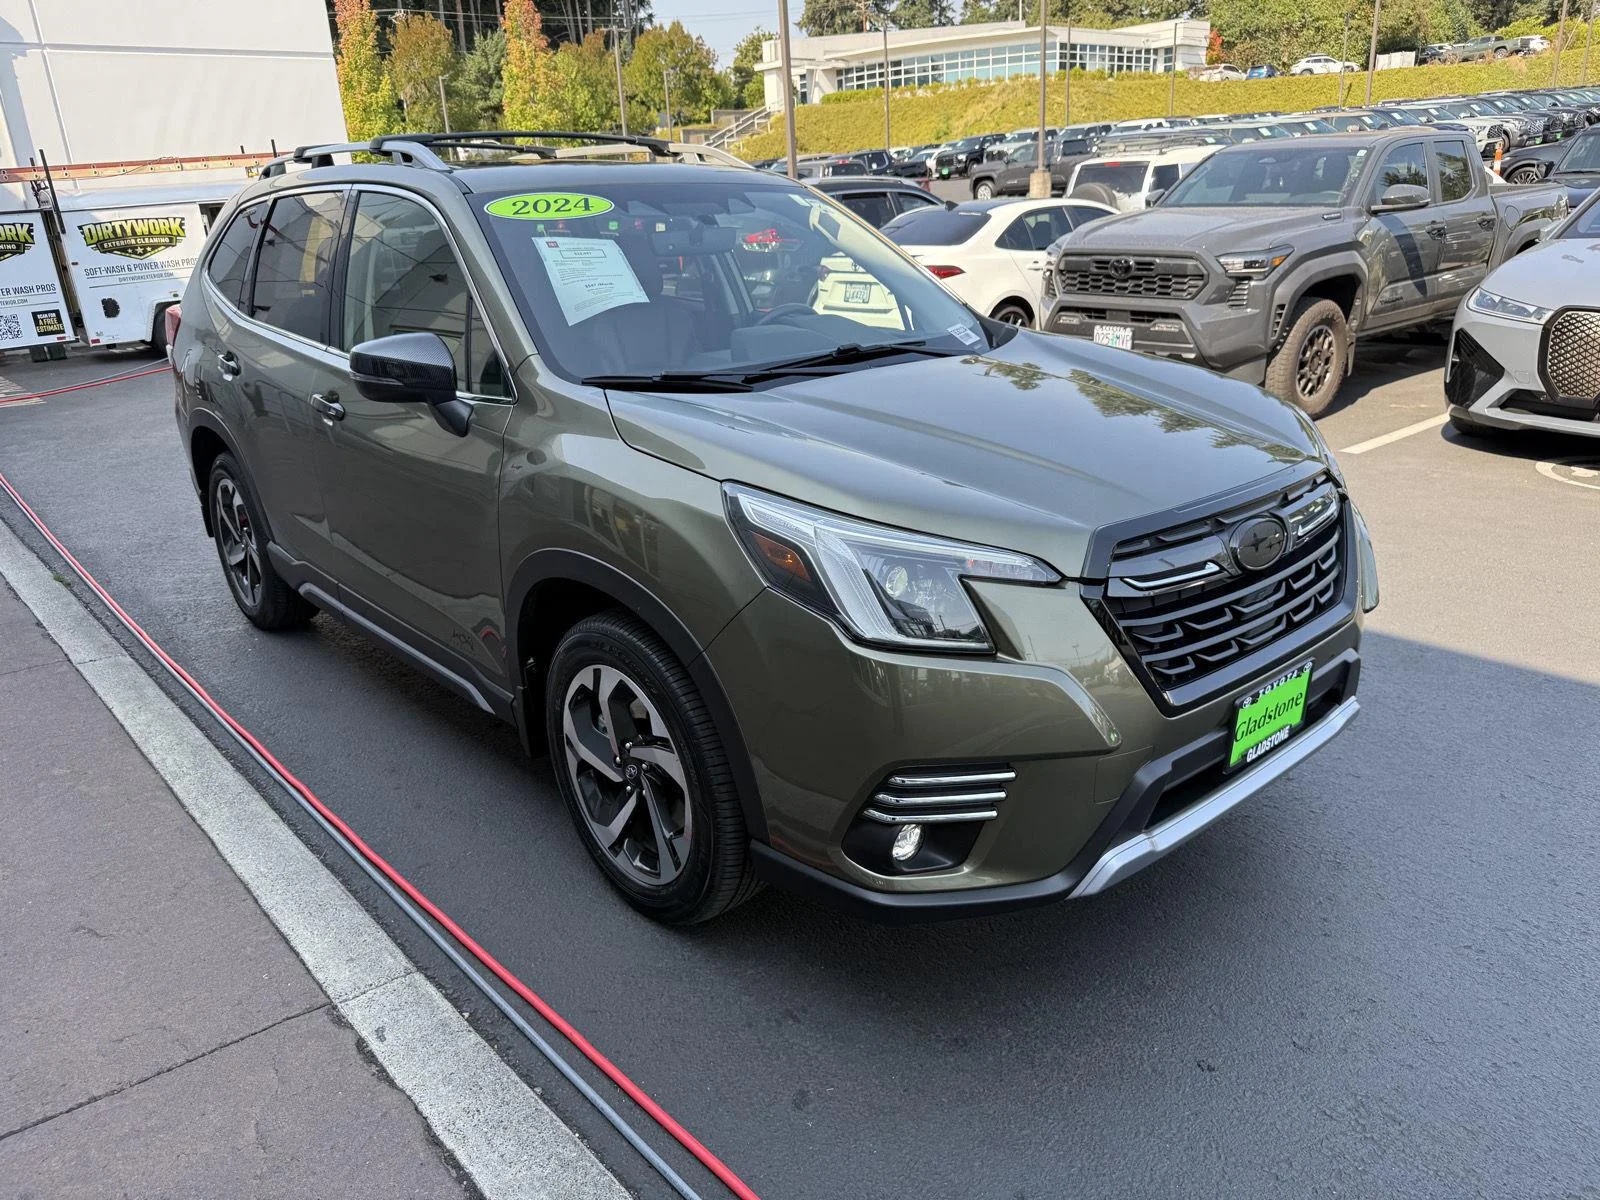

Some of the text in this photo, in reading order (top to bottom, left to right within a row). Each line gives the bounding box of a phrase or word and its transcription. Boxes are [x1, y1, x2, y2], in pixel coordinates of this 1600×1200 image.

[511, 197, 595, 216] 2024
[82, 217, 186, 245] DIRTYWORK
[104, 237, 170, 249] EXTERIOR CLEANING
[84, 265, 126, 277] SOFT-WASH
[127, 264, 132, 272] &
[133, 262, 160, 272] POWER
[160, 259, 180, 269] WASH
[12, 285, 35, 295] WASH
[36, 283, 56, 293] PROS
[36, 323, 64, 332] ESTIMATE
[44, 317, 58, 325] FREE
[1258, 669, 1298, 697] TOYOTA
[1234, 692, 1303, 742] Gladstone
[1246, 725, 1291, 763] GLADSTONE
